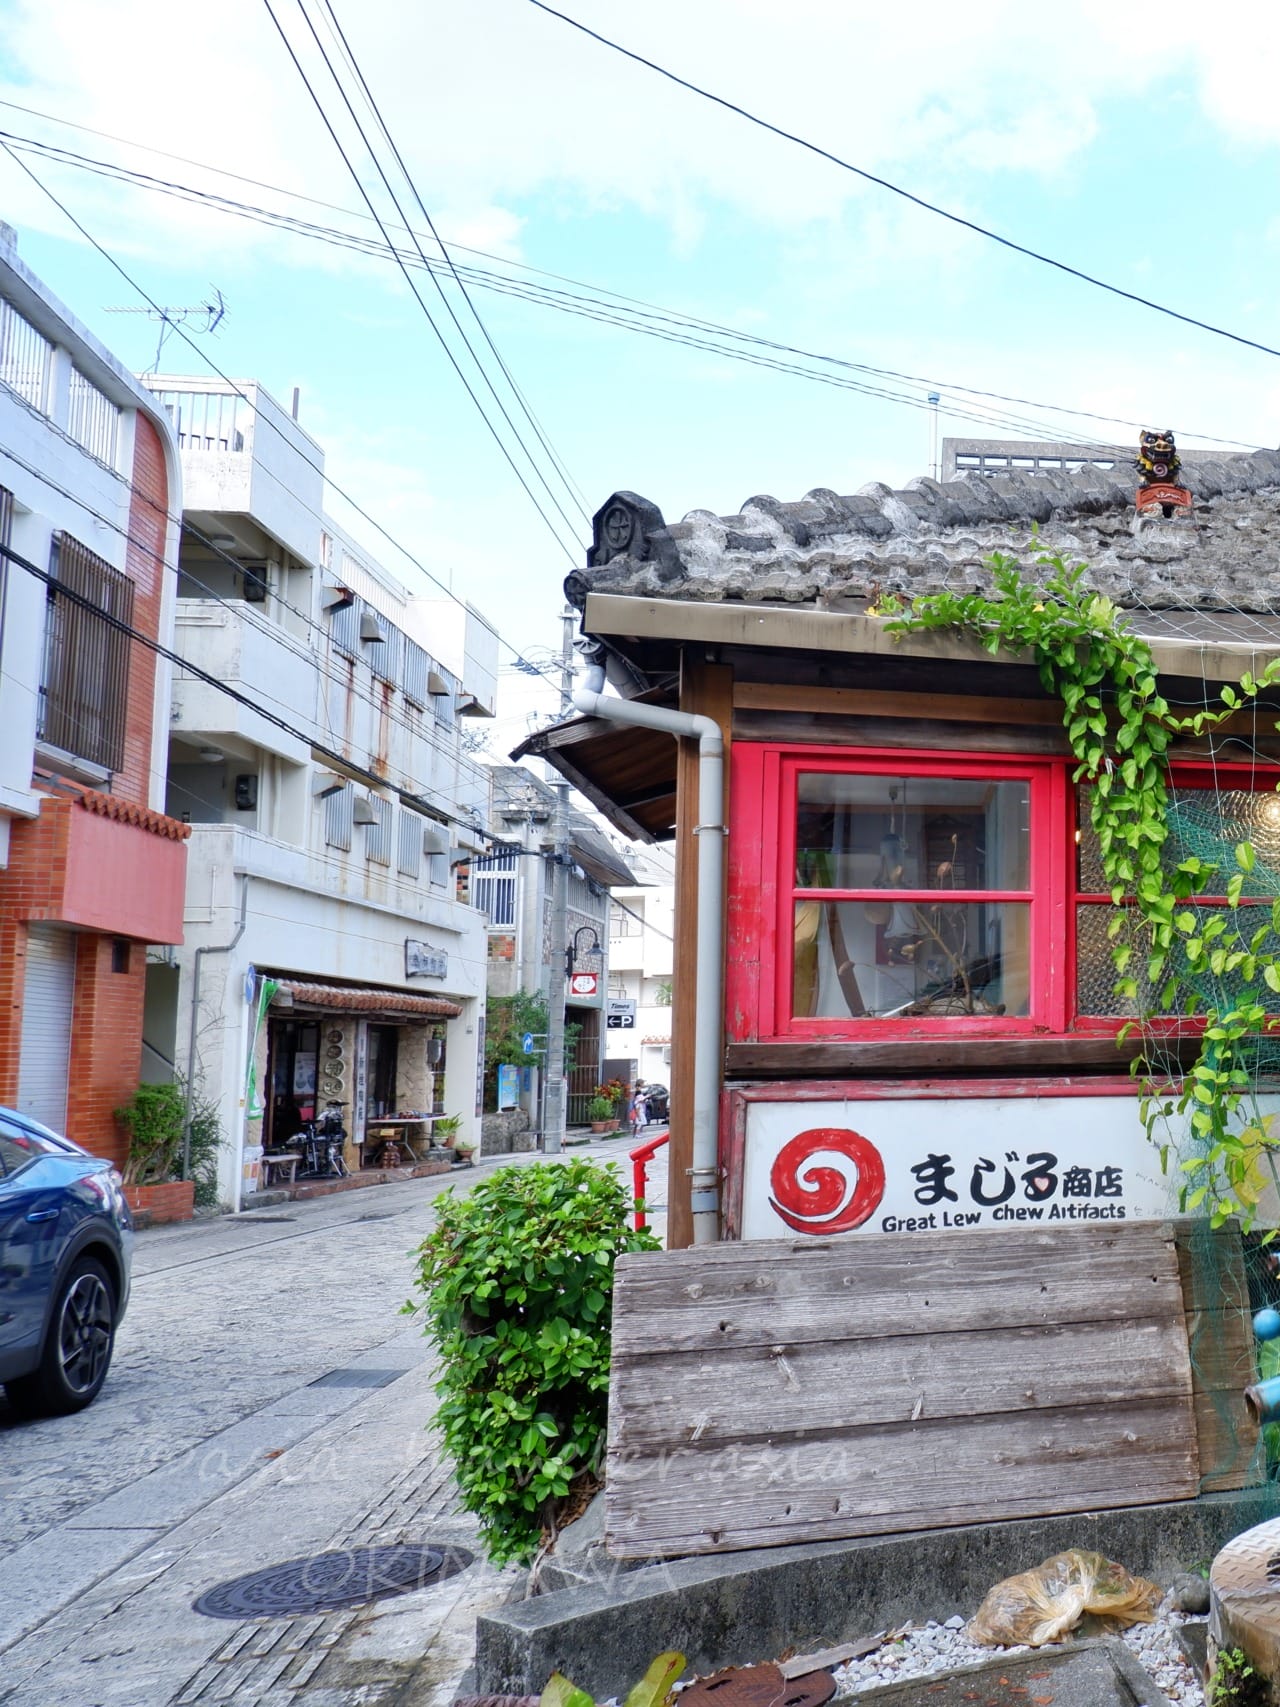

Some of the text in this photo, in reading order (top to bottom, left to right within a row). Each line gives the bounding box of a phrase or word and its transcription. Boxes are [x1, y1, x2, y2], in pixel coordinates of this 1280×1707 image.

[621, 1016, 632, 1027] P
[910, 1151, 1123, 1206] まじる商店
[882, 1213, 937, 1232] Great
[943, 1211, 981, 1227] Lew
